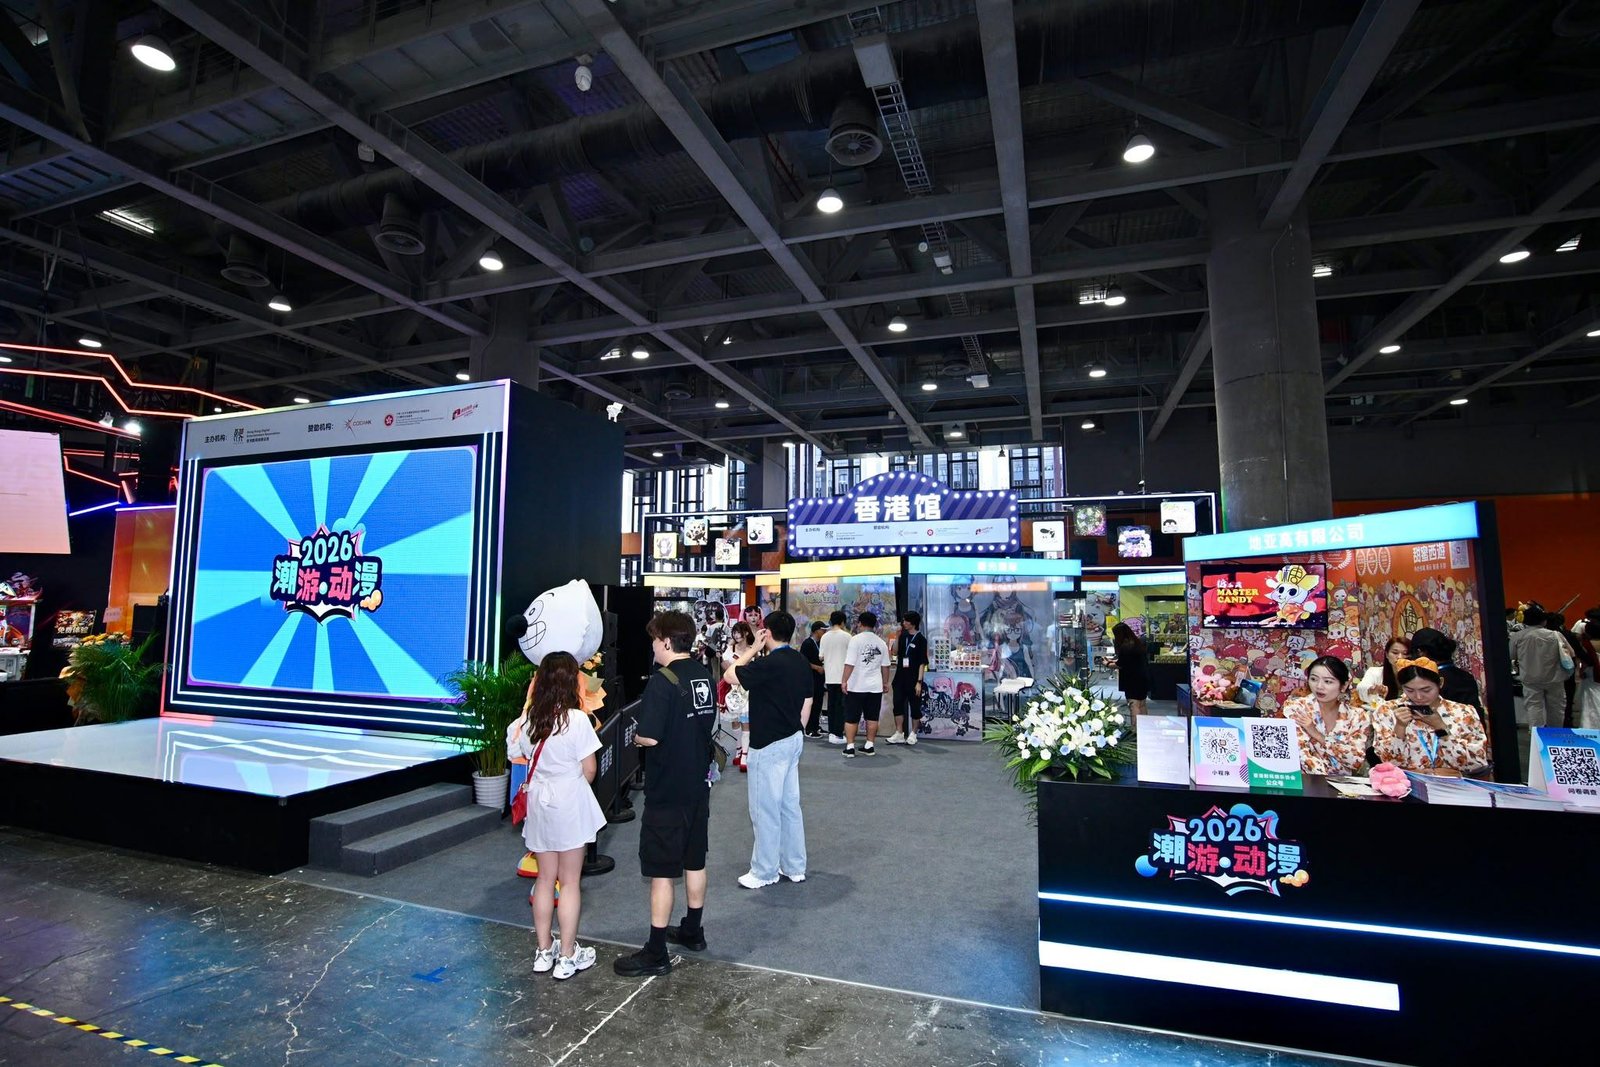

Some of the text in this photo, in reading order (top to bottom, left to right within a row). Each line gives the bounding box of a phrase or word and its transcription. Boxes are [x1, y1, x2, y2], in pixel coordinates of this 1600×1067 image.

[854, 493, 941, 522] 香港馆
[302, 534, 352, 566] 2026
[1217, 588, 1259, 596] MASTER
[1189, 818, 1262, 842] 2026
